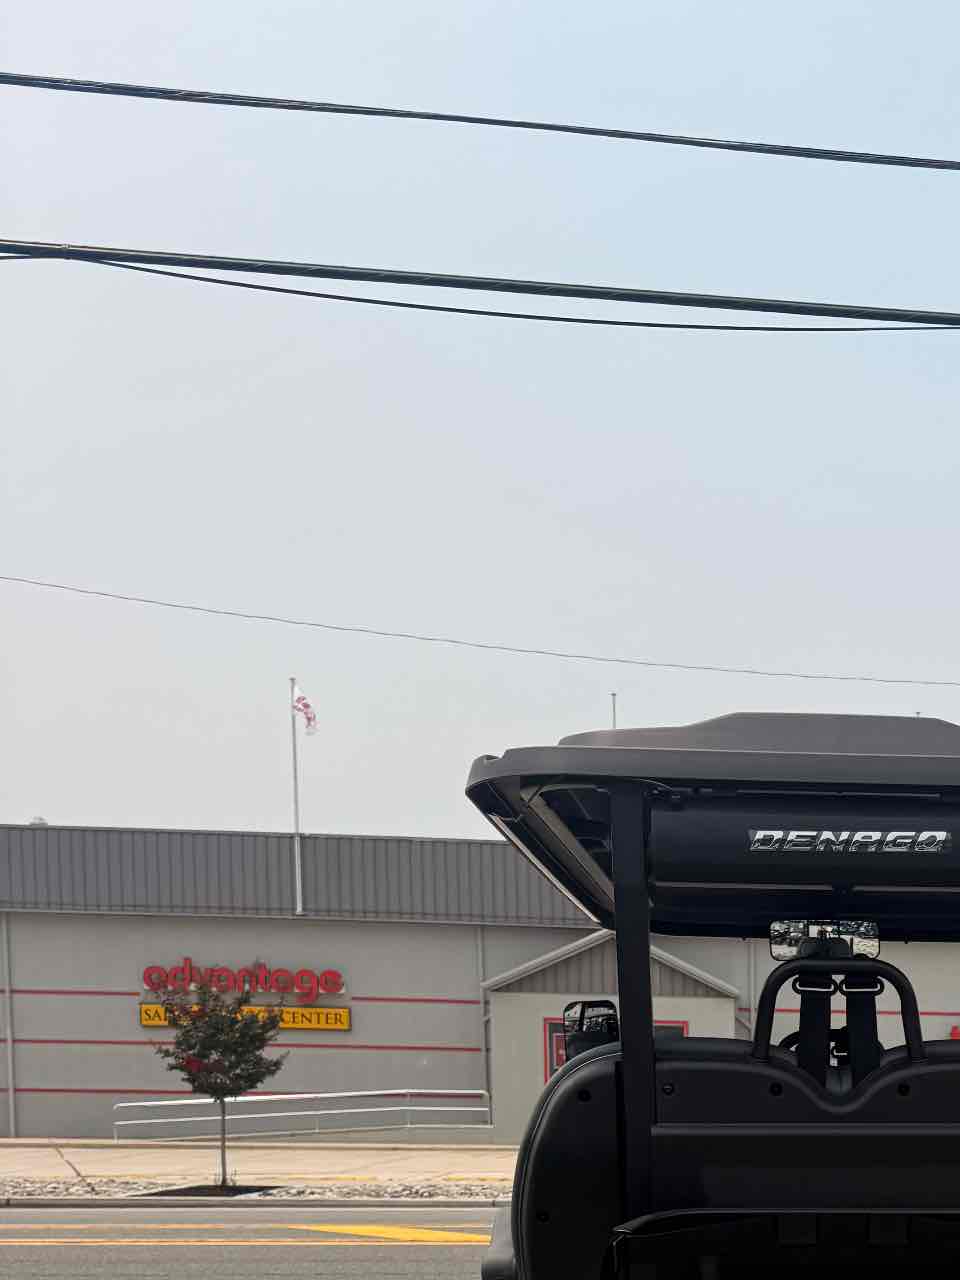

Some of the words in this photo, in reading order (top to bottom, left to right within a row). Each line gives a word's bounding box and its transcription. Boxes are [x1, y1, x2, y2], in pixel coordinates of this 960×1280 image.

[750, 830, 947, 851] DENAGO
[143, 957, 344, 1004] advantage
[279, 1009, 345, 1025] CENTER
